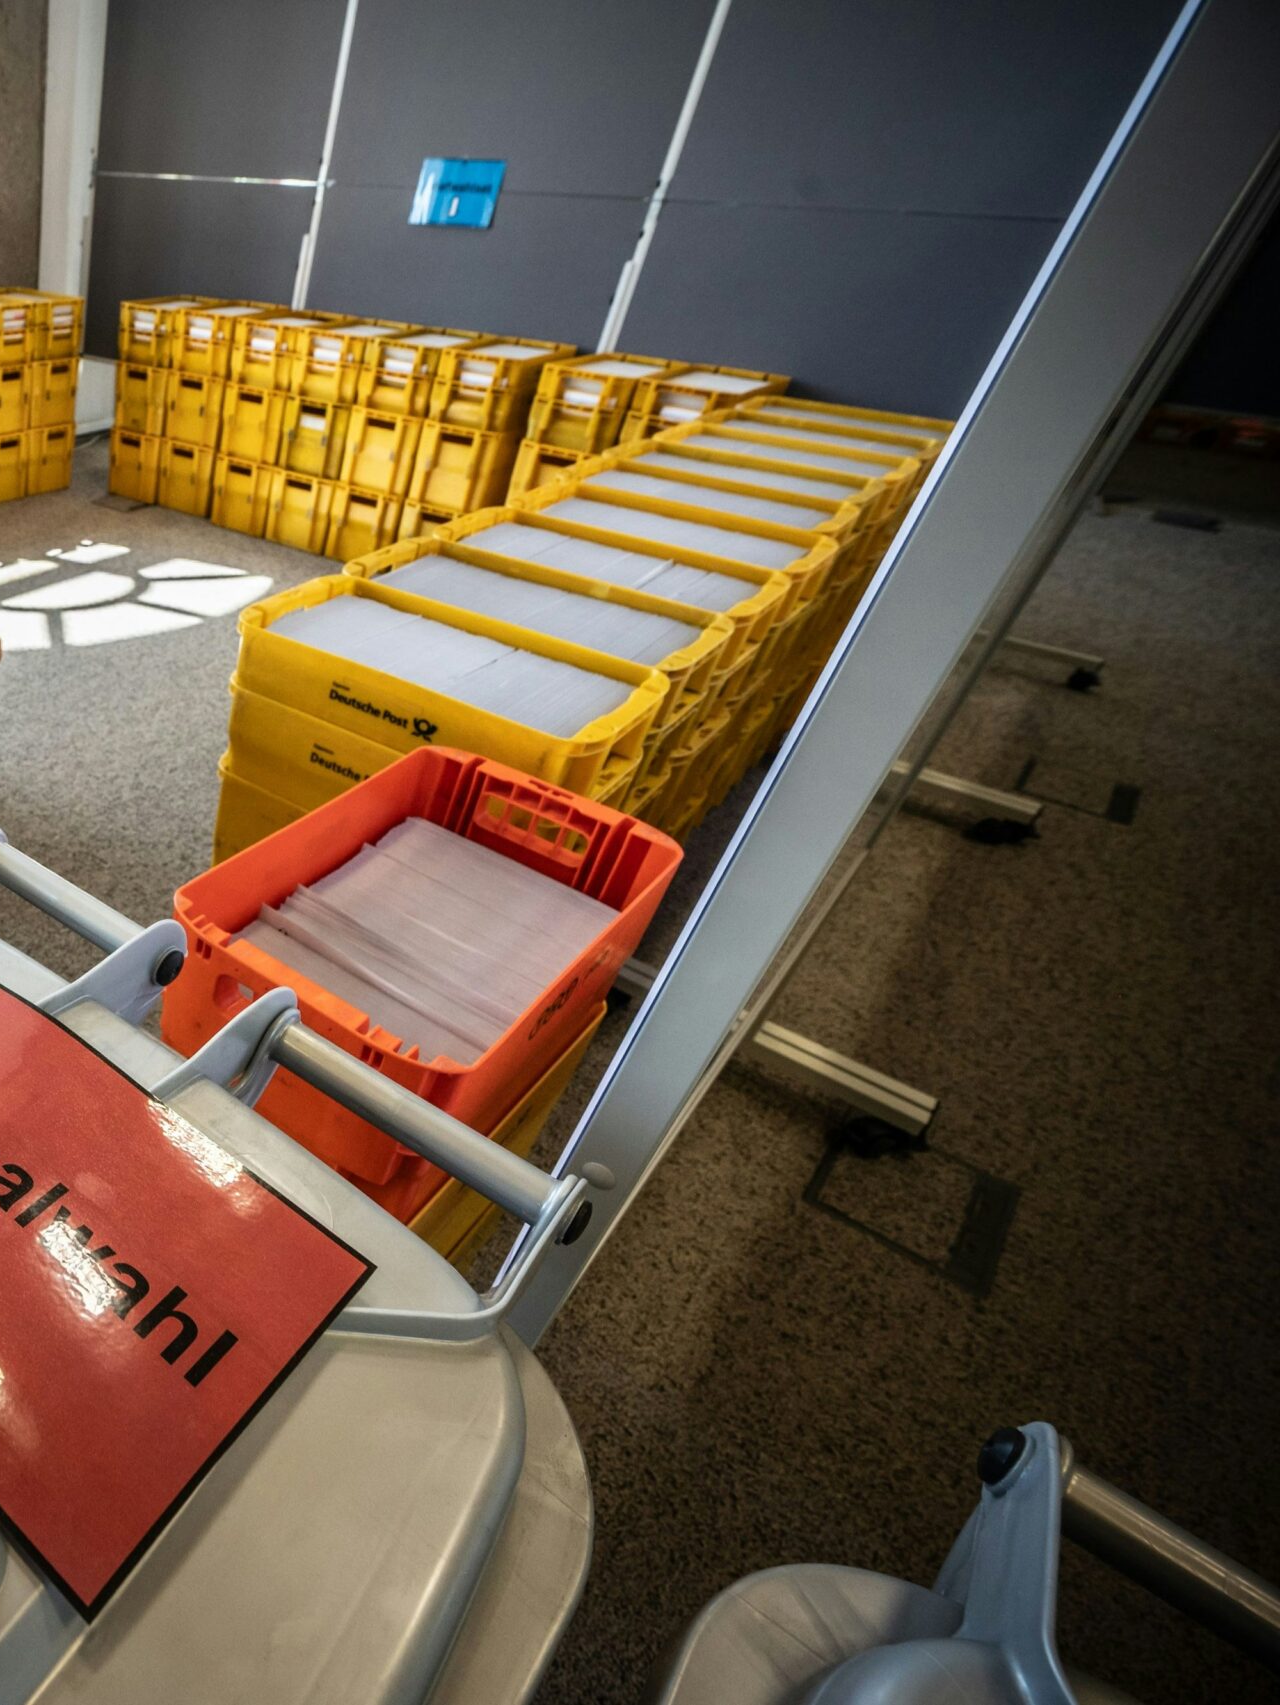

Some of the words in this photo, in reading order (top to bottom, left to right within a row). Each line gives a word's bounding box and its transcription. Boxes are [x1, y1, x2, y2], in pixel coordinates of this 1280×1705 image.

[328, 688, 381, 718] Deutsche
[383, 709, 408, 729] Post
[309, 751, 361, 782] Deutsche
